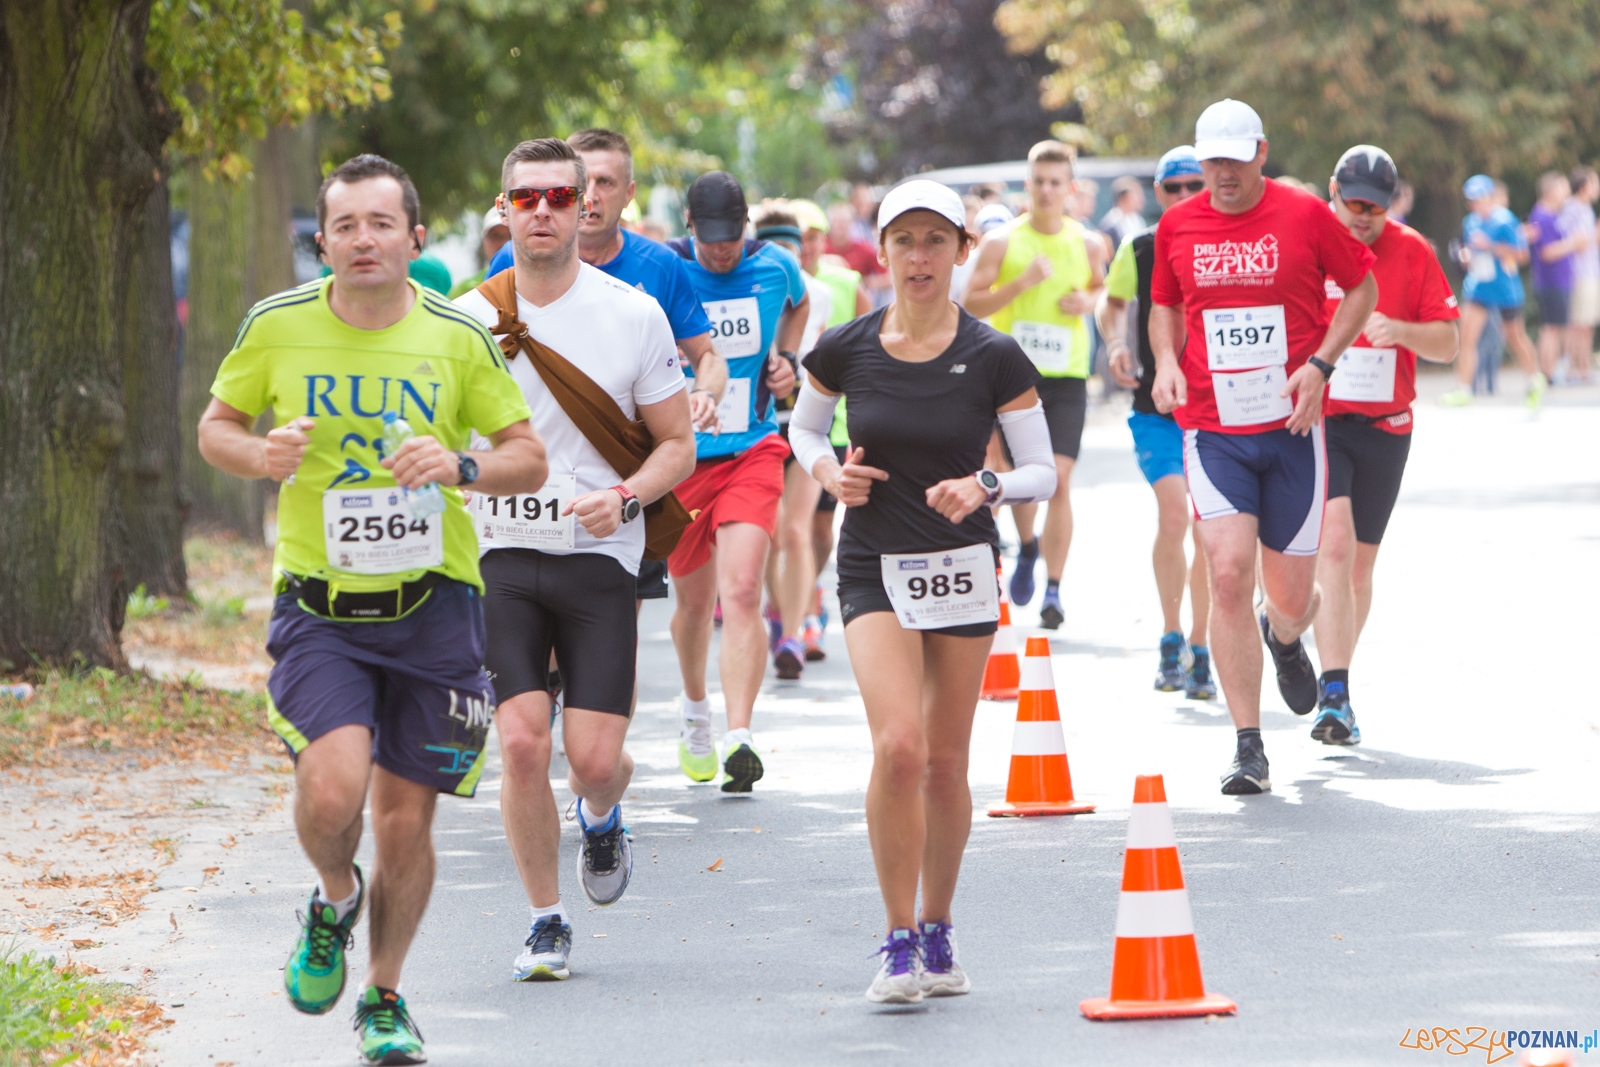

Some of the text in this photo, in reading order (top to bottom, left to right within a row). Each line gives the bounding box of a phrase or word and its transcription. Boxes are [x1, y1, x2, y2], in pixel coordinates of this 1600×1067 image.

[1193, 239, 1264, 257] DRUŻYNA
[1193, 253, 1279, 277] SZPIKU
[1215, 325, 1275, 347] 1597
[303, 374, 442, 424] RUN
[488, 496, 559, 522] 1191
[339, 514, 429, 542] 2564
[506, 526, 523, 534] BIEG
[525, 527, 564, 536] LECHITÓW
[908, 572, 973, 600] 985
